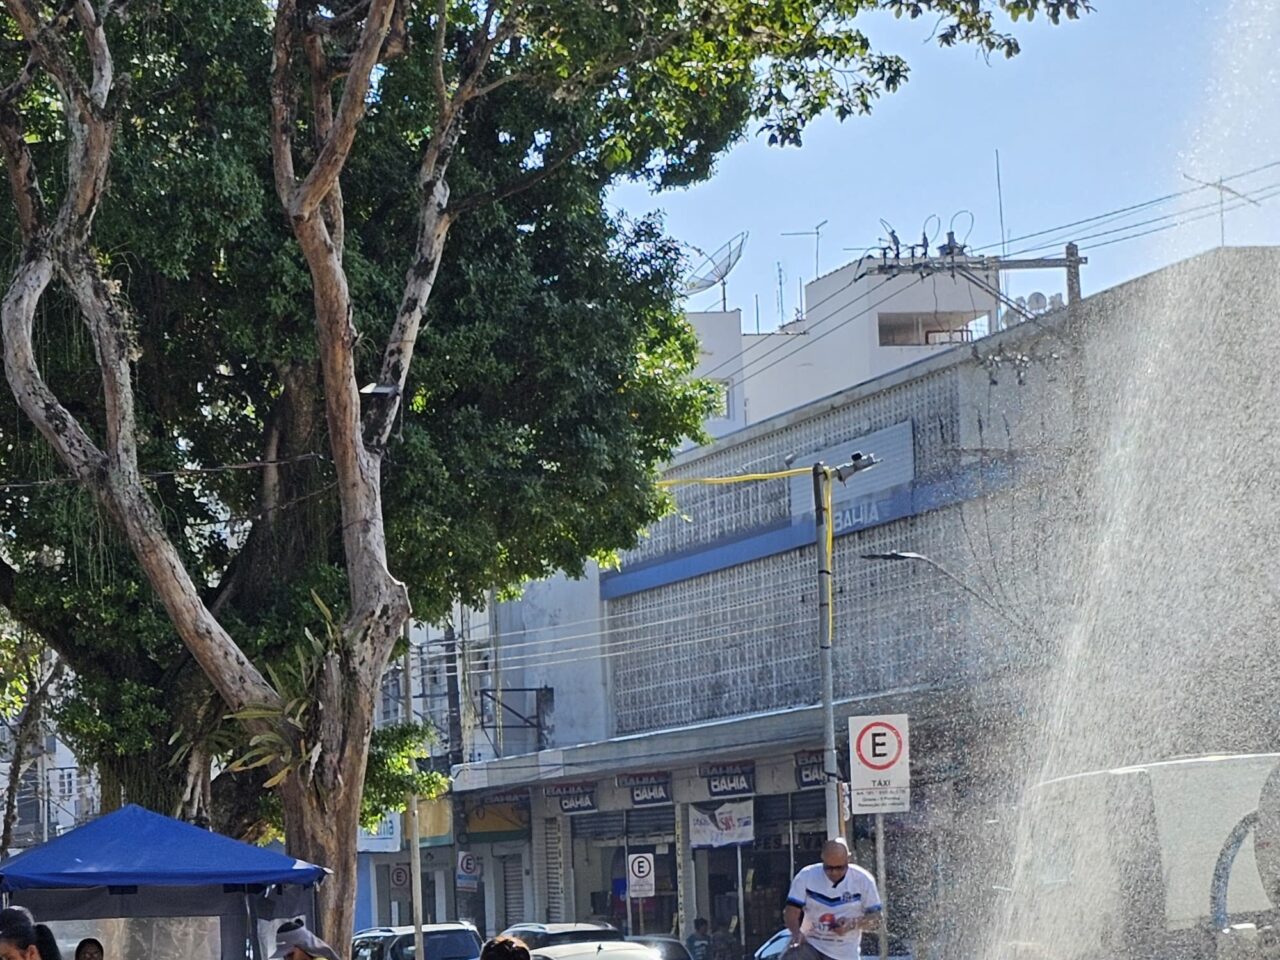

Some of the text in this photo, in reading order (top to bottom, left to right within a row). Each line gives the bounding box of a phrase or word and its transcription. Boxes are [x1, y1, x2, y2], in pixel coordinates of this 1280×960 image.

[871, 732, 888, 758] E
[711, 775, 748, 793] BAHIA
[637, 861, 645, 874] E
